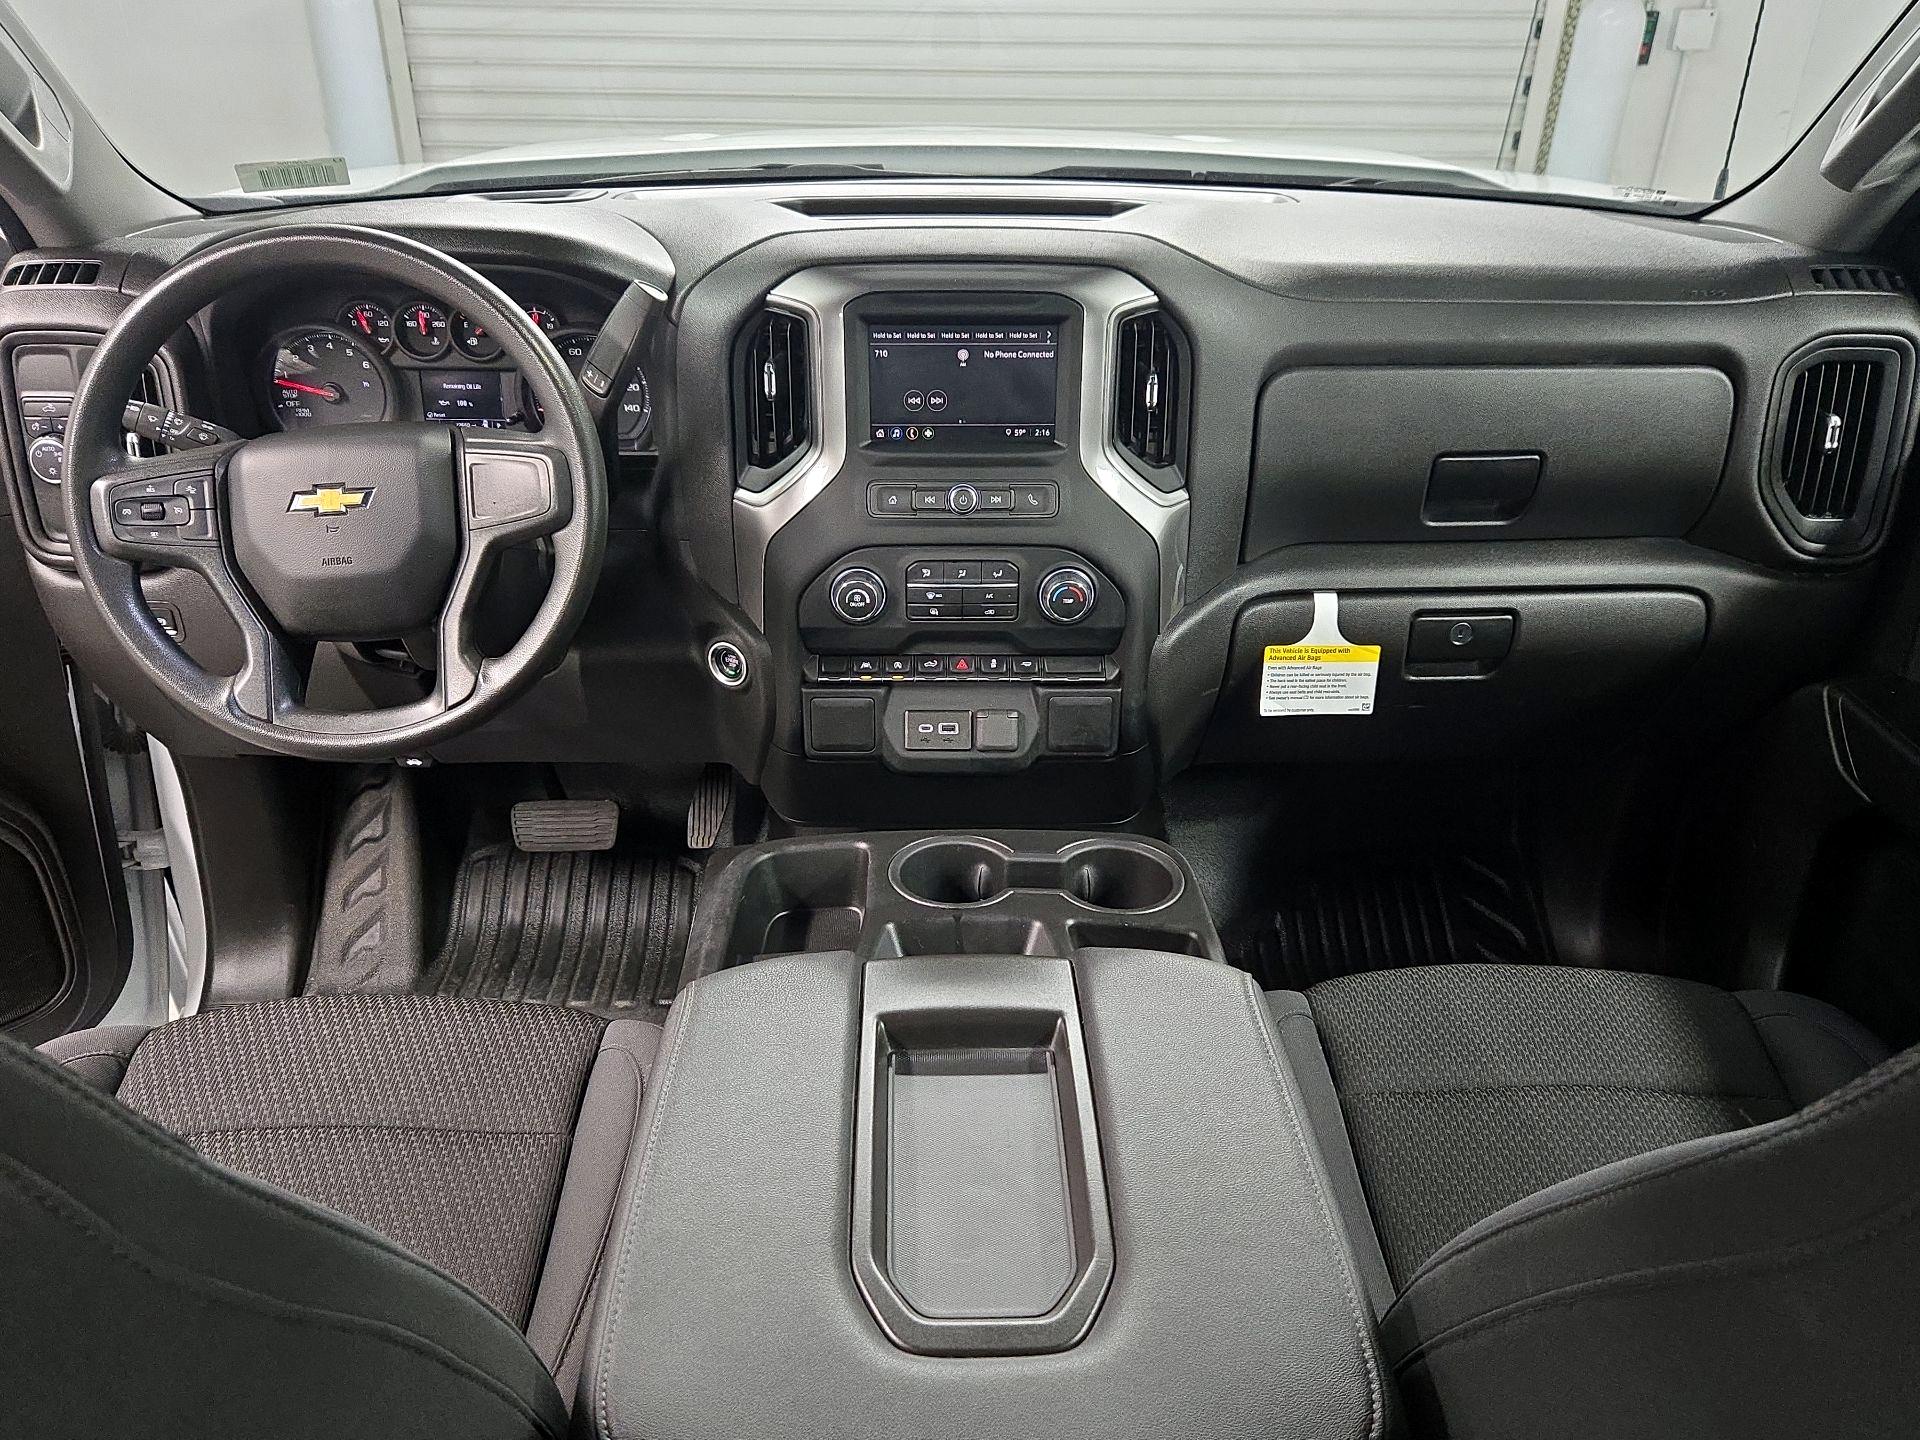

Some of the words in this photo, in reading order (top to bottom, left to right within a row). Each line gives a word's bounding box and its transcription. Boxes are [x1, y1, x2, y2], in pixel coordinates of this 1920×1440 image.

[873, 332, 886, 340] Hold
[893, 332, 901, 340] Set
[907, 332, 920, 340] Hold
[927, 332, 935, 340] Set
[942, 332, 954, 340] Hold
[961, 332, 969, 340] Set
[976, 332, 988, 340] Hold
[996, 332, 1004, 340] Set
[1010, 332, 1022, 340] Hold
[1029, 332, 1038, 340] Set
[326, 342, 333, 350] 4
[568, 348, 582, 356] 60
[874, 350, 888, 358] 710
[984, 350, 994, 359] No
[995, 350, 1017, 359] Phone
[1017, 350, 1054, 359] Connected
[362, 361, 370, 369] 6
[626, 384, 640, 392] 20
[624, 404, 641, 412] 140
[1034, 429, 1050, 437] 2:16
[322, 556, 353, 566] AIRBAG
